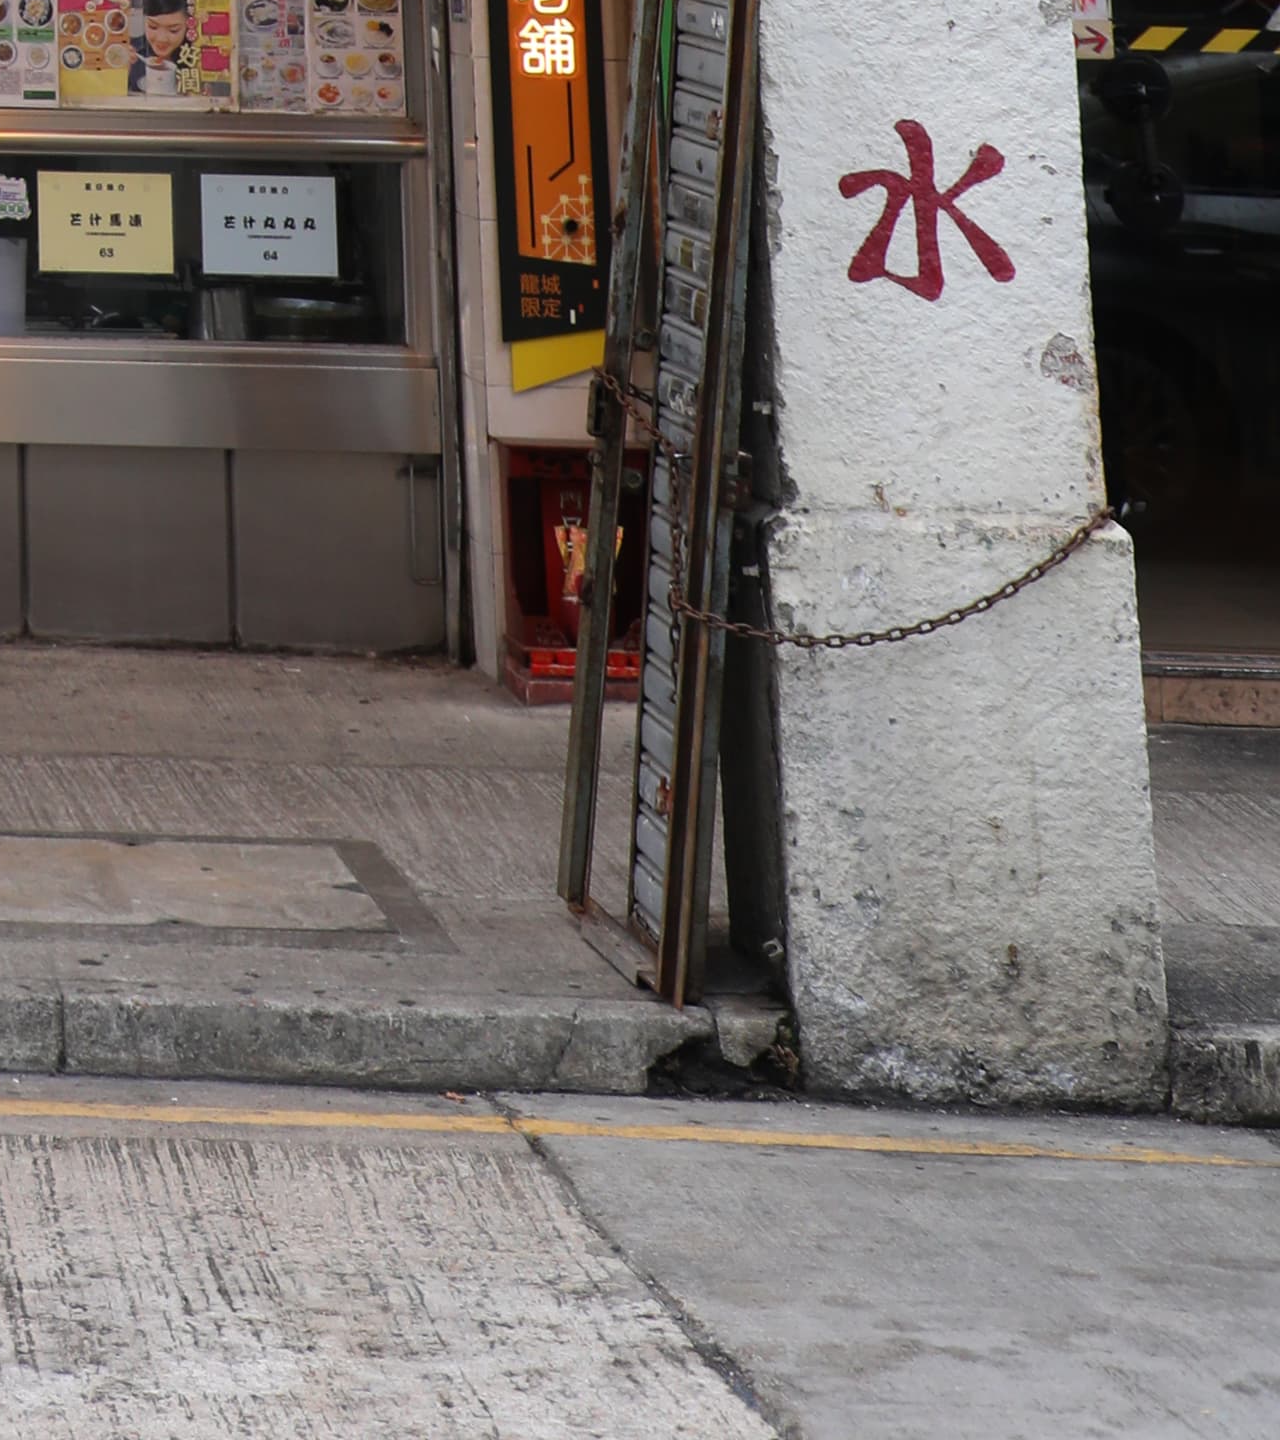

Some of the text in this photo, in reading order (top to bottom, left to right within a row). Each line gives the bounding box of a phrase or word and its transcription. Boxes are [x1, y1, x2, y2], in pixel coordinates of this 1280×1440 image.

[99, 247, 114, 258] 63
[263, 250, 278, 261] 64
[519, 274, 561, 296] 龍城
[519, 297, 561, 319] 限定
